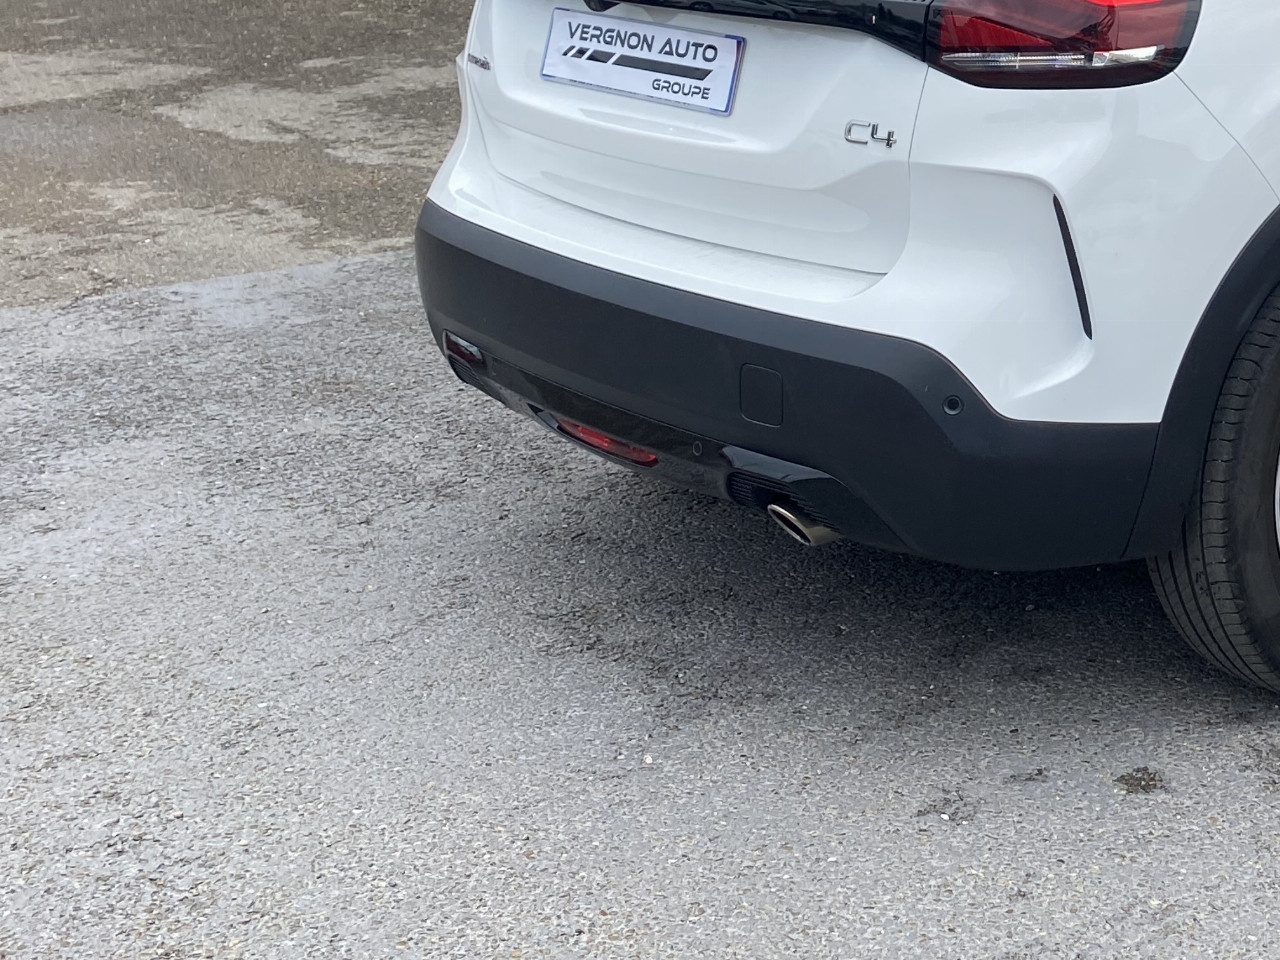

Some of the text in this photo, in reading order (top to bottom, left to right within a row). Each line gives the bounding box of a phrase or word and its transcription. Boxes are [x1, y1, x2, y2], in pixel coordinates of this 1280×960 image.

[567, 21, 719, 63] VERGNON AUTO
[651, 78, 711, 100] GROUPE
[844, 119, 898, 149] C4
